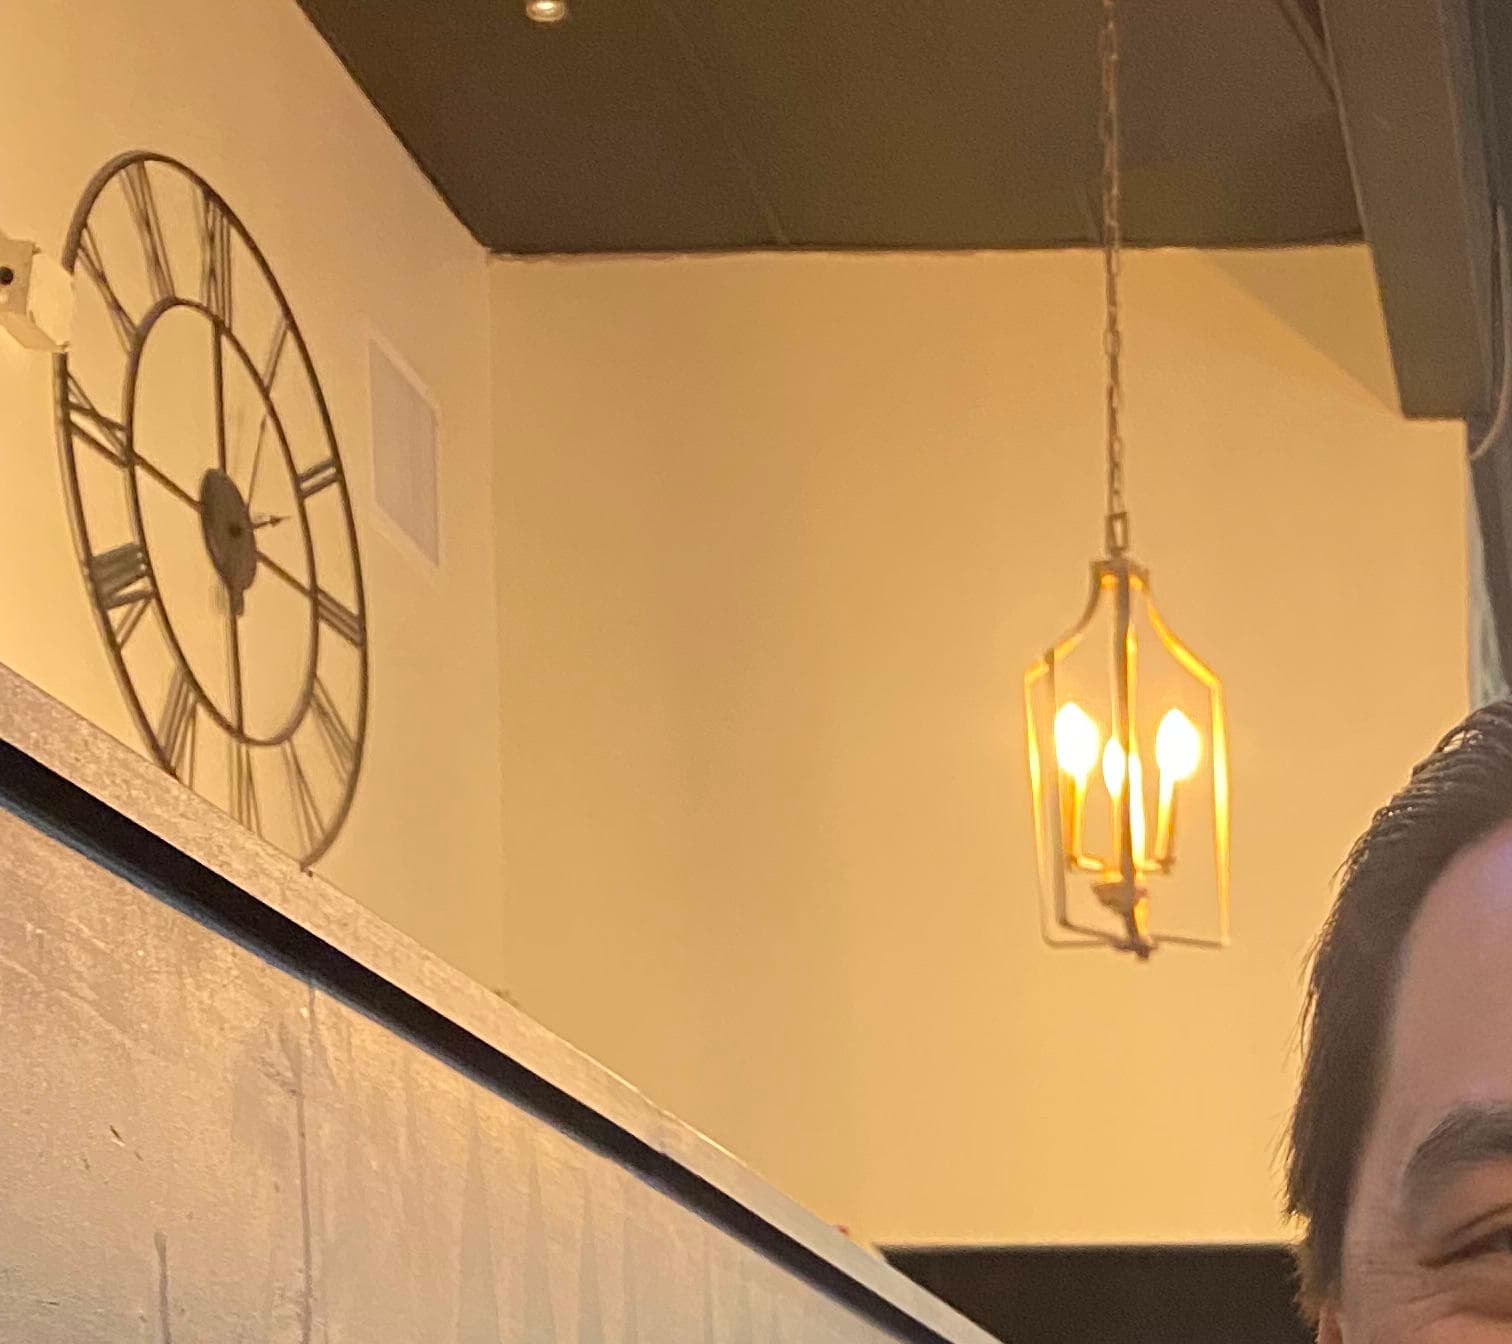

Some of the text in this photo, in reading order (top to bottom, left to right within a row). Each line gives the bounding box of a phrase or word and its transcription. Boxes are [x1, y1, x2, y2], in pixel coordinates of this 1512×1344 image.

[198, 188, 232, 330] XII
[298, 457, 342, 498] II
[314, 586, 366, 650] III
